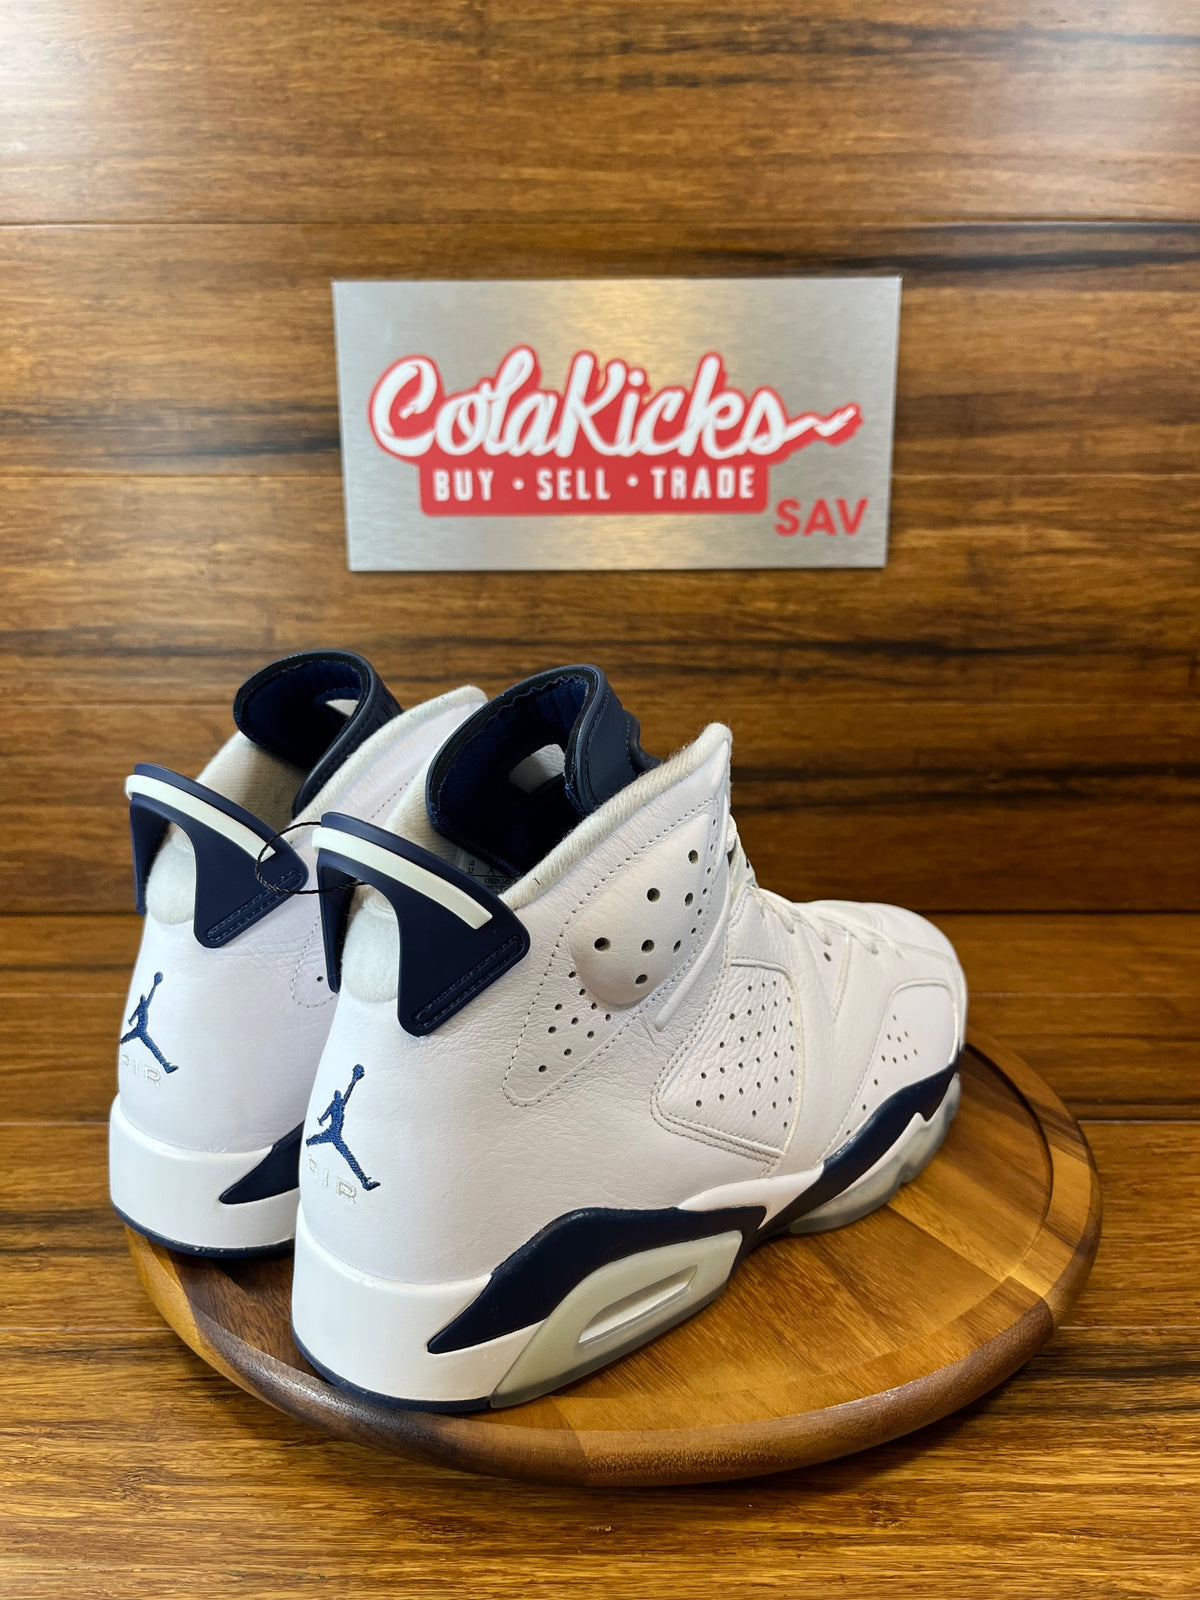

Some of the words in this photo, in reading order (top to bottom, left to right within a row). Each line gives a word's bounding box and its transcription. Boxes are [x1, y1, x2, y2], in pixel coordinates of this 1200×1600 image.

[370, 347, 860, 459] ColaKicks
[433, 469, 494, 501] BUY
[536, 468, 610, 500] SELL
[652, 466, 755, 499] TRADE
[775, 497, 867, 537] SAV
